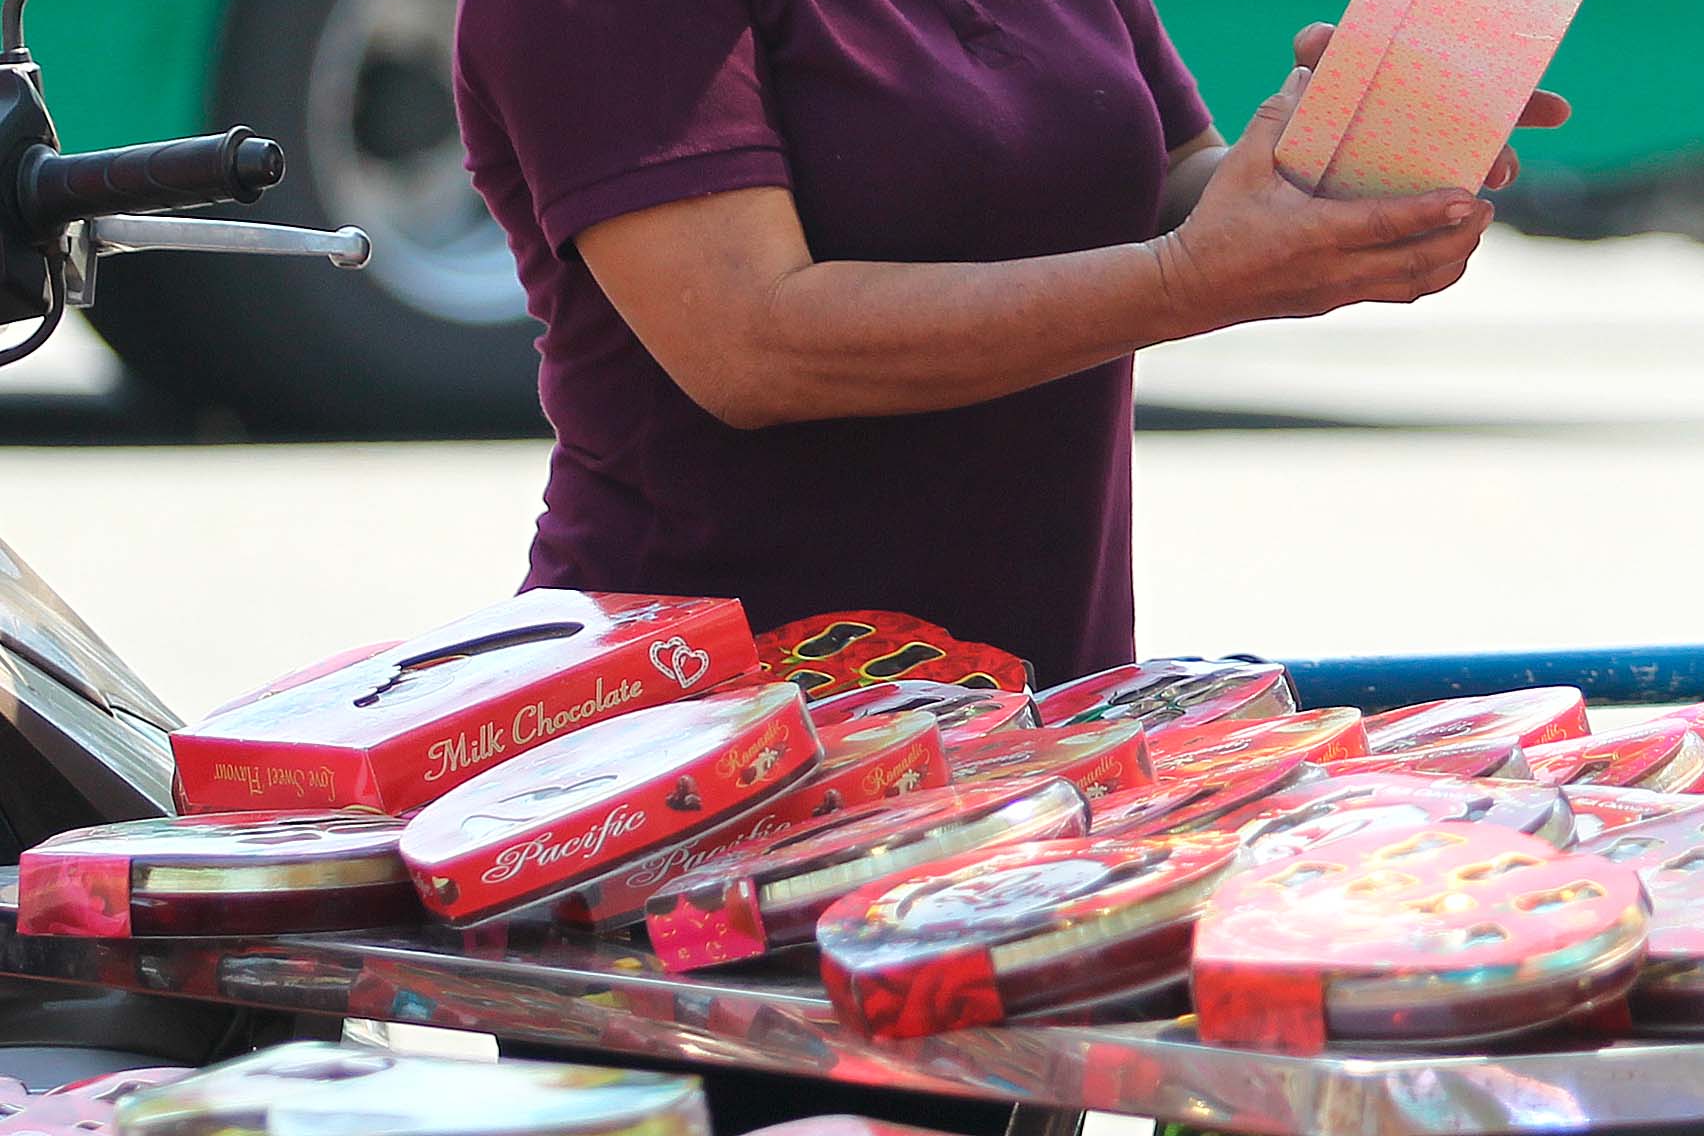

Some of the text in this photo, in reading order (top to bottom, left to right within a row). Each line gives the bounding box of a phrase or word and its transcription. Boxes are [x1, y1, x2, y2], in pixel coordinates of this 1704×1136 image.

[423, 676, 644, 782] Milk Chocolate
[715, 719, 790, 778] Romantic
[214, 763, 336, 802] Love Sweet Flavour
[862, 741, 931, 795] Romantic
[1076, 753, 1123, 786] mantic
[481, 804, 647, 885] Pacific
